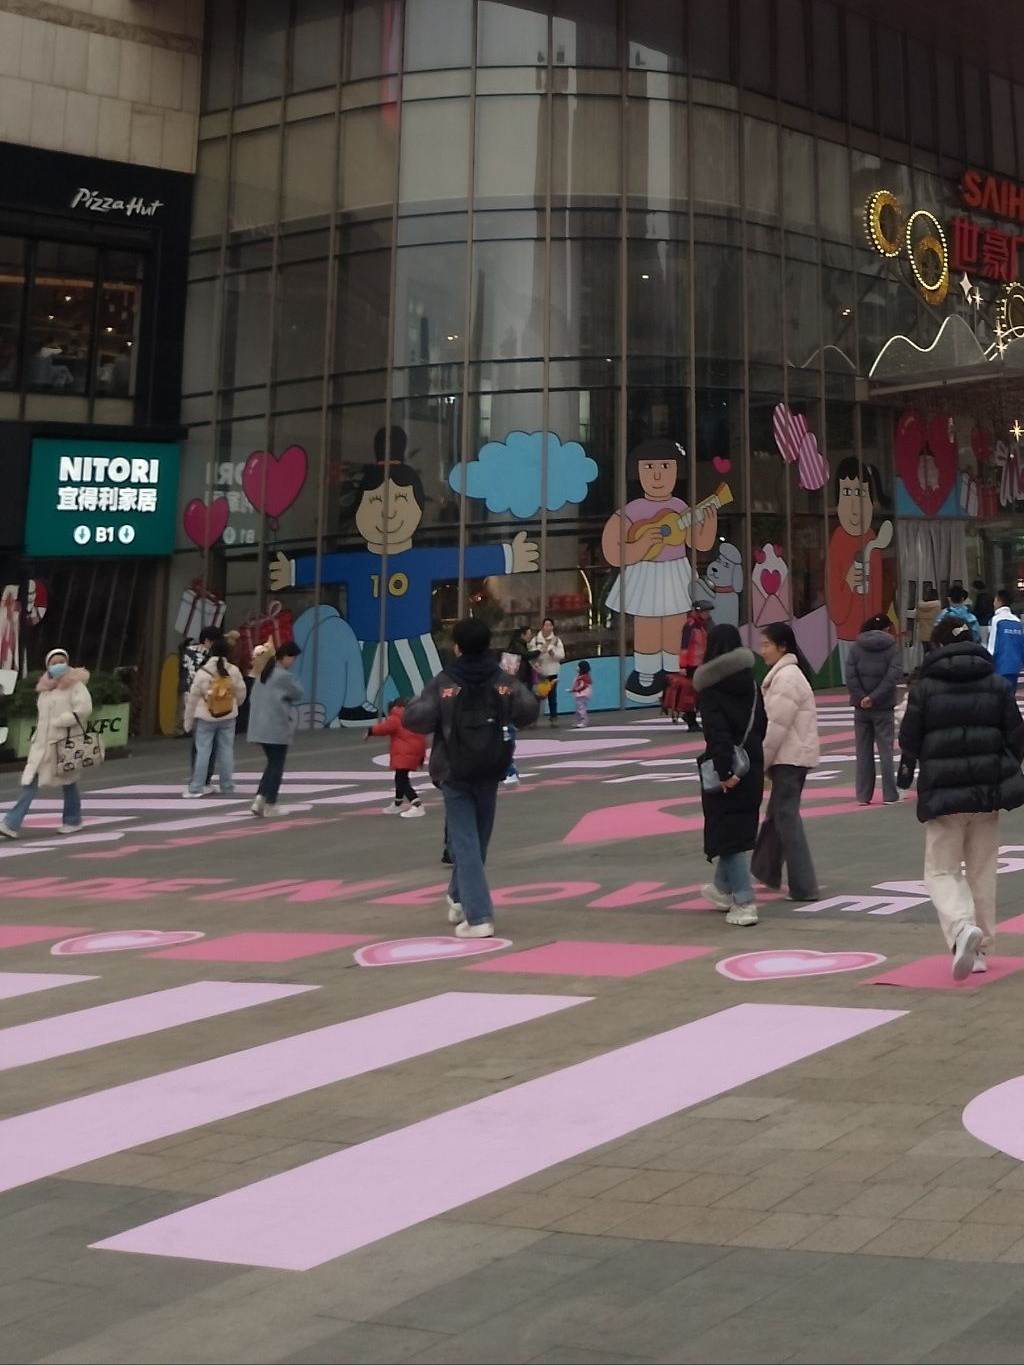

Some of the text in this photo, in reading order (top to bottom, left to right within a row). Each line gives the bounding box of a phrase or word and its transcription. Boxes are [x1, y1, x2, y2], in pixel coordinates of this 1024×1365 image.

[70, 187, 164, 217] Pizza Hut
[59, 456, 160, 484] NITORI
[57, 486, 157, 513] 宜得利家居
[95, 526, 115, 543] B1
[370, 572, 409, 598] 10
[87, 717, 122, 734] KFC
[0, 877, 235, 901] ADE
[189, 879, 398, 902] IN
